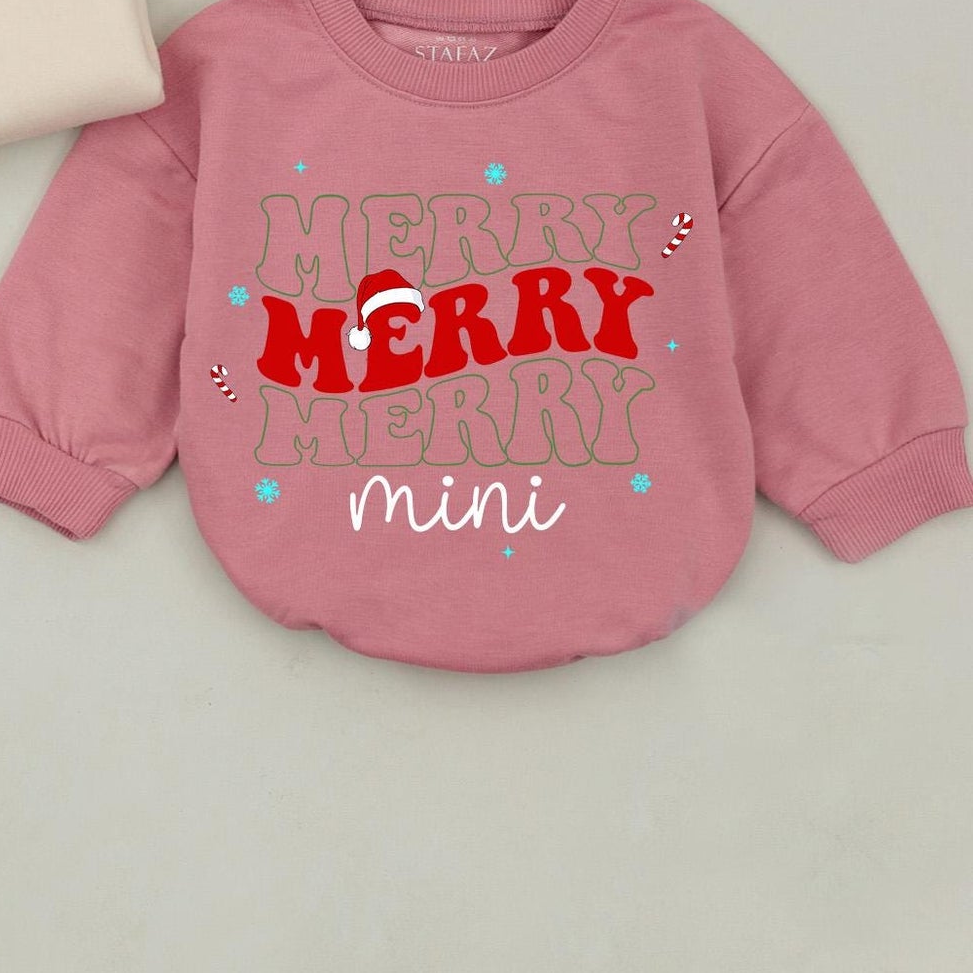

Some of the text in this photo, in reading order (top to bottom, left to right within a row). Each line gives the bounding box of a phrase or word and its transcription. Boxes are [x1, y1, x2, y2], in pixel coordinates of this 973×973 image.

[415, 45, 498, 62] STAFAZ
[255, 193, 657, 302] MERRY
[257, 267, 654, 393] MERRY
[254, 358, 656, 467] MERRY
[350, 475, 566, 533] mini
